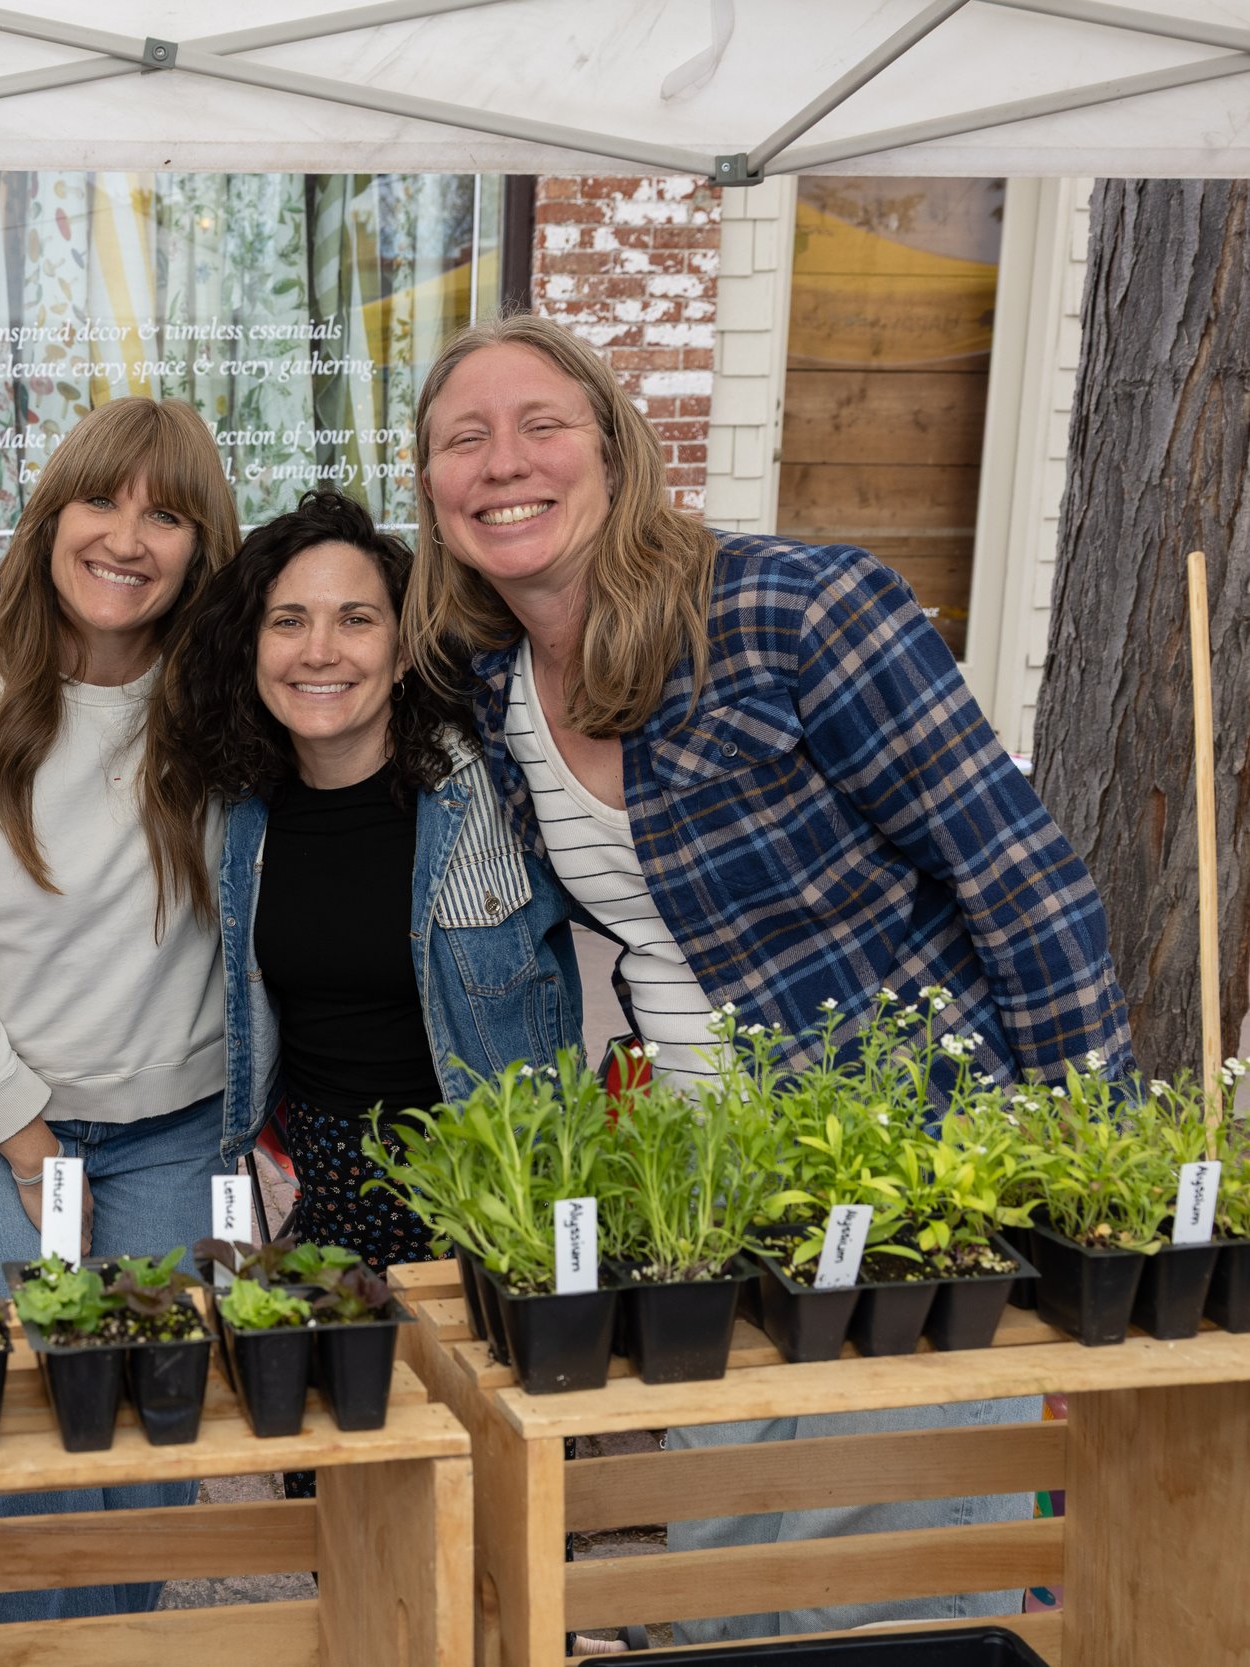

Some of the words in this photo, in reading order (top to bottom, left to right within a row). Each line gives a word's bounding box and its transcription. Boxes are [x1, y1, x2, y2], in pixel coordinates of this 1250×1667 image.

[76, 318, 131, 344] décor
[138, 318, 160, 341] &
[165, 317, 243, 341] timeless
[249, 315, 342, 340] essentials
[72, 361, 126, 384] every
[132, 358, 186, 384] space
[193, 354, 214, 376] &
[219, 358, 273, 383] every
[278, 351, 378, 384] gathering.
[282, 421, 305, 453] of
[305, 428, 355, 453] your
[245, 458, 267, 480] &
[272, 455, 358, 487] uniquely
[52, 1159, 66, 1213] Lettuce
[223, 1179, 236, 1230] Lettuce
